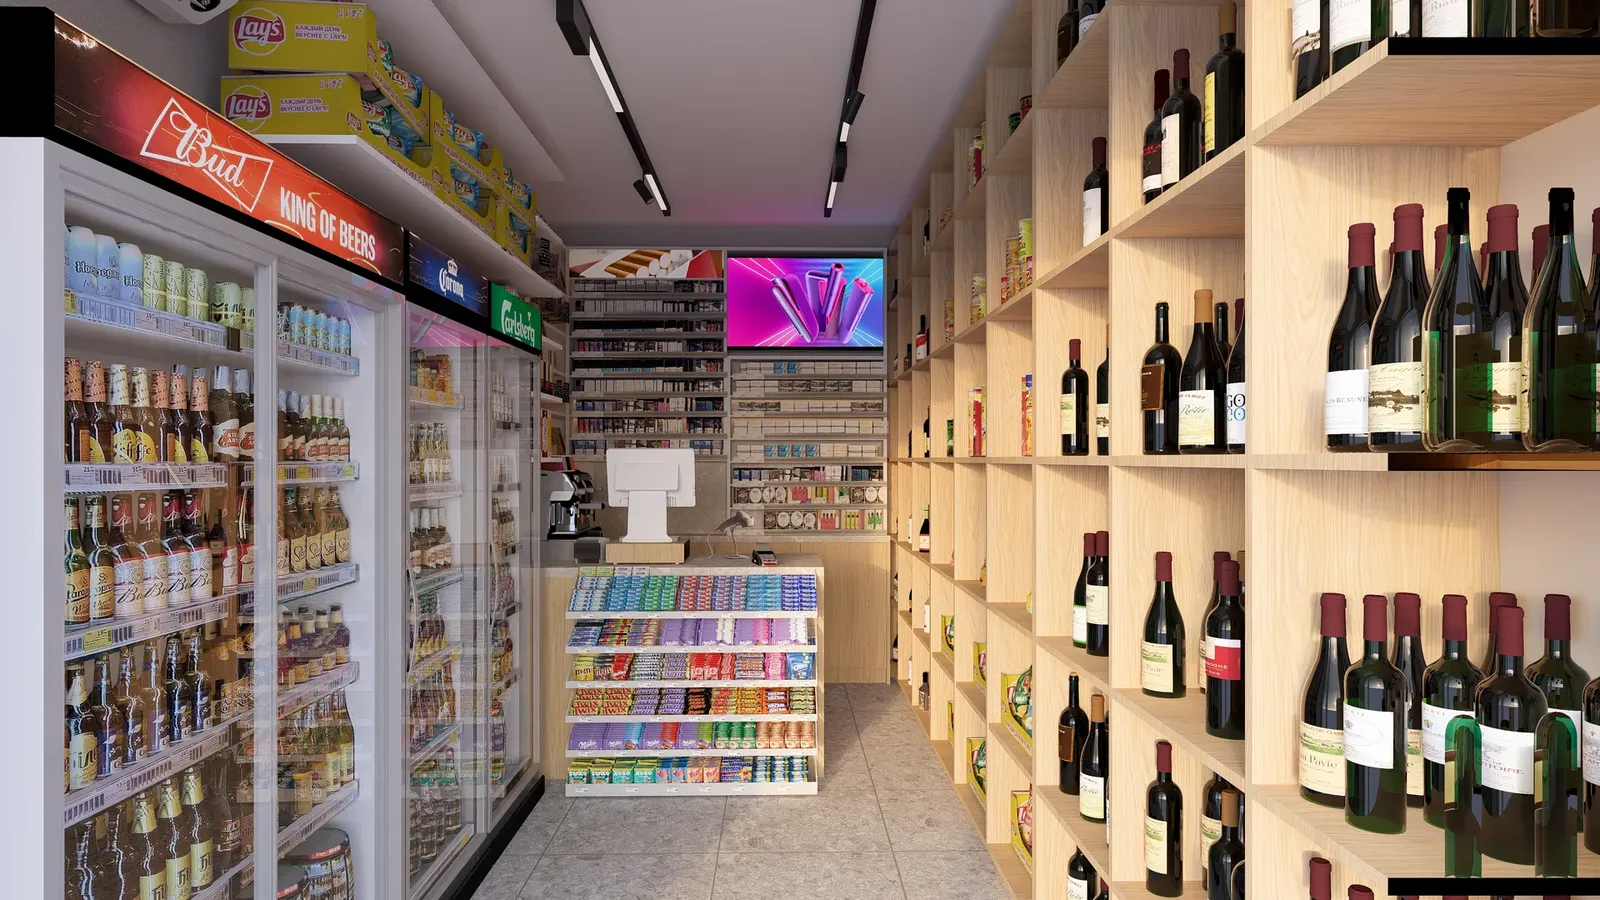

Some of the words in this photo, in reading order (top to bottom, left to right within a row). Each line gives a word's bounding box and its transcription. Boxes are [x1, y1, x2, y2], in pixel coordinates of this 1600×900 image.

[237, 16, 282, 46] Lay's
[228, 95, 269, 123] Lay's
[169, 110, 245, 188] Bud
[280, 186, 317, 234] KING
[319, 208, 337, 241] OF
[339, 218, 377, 262] BEERS
[438, 267, 466, 300] Corona
[501, 299, 536, 347] Carlsberg
